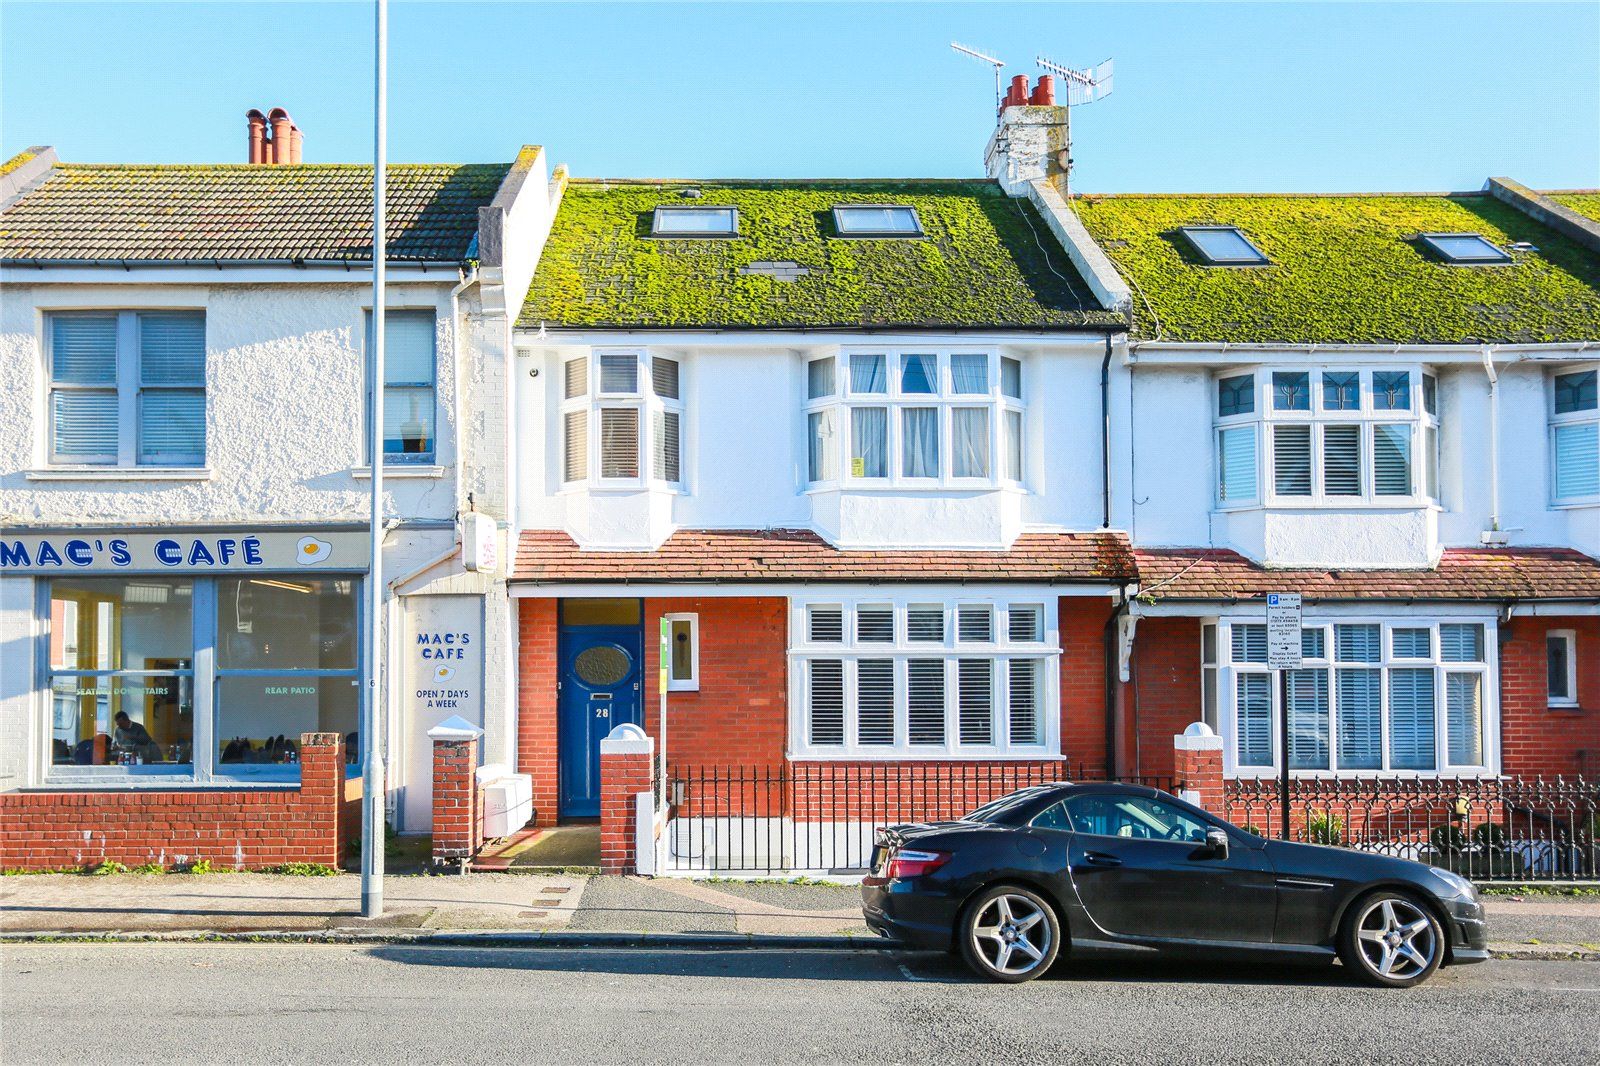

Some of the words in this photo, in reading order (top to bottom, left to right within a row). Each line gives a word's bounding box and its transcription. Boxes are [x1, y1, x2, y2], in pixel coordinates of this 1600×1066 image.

[0, 539, 132, 567] MAC'S
[153, 535, 263, 567] CAFÉ
[417, 633, 470, 645] MAC'S
[422, 648, 464, 659] CAFE
[114, 687, 169, 696] DOTAIRS
[416, 690, 438, 698] OPEN
[440, 690, 445, 698] 7
[447, 690, 469, 698] DAYS
[596, 708, 608, 718] 28
